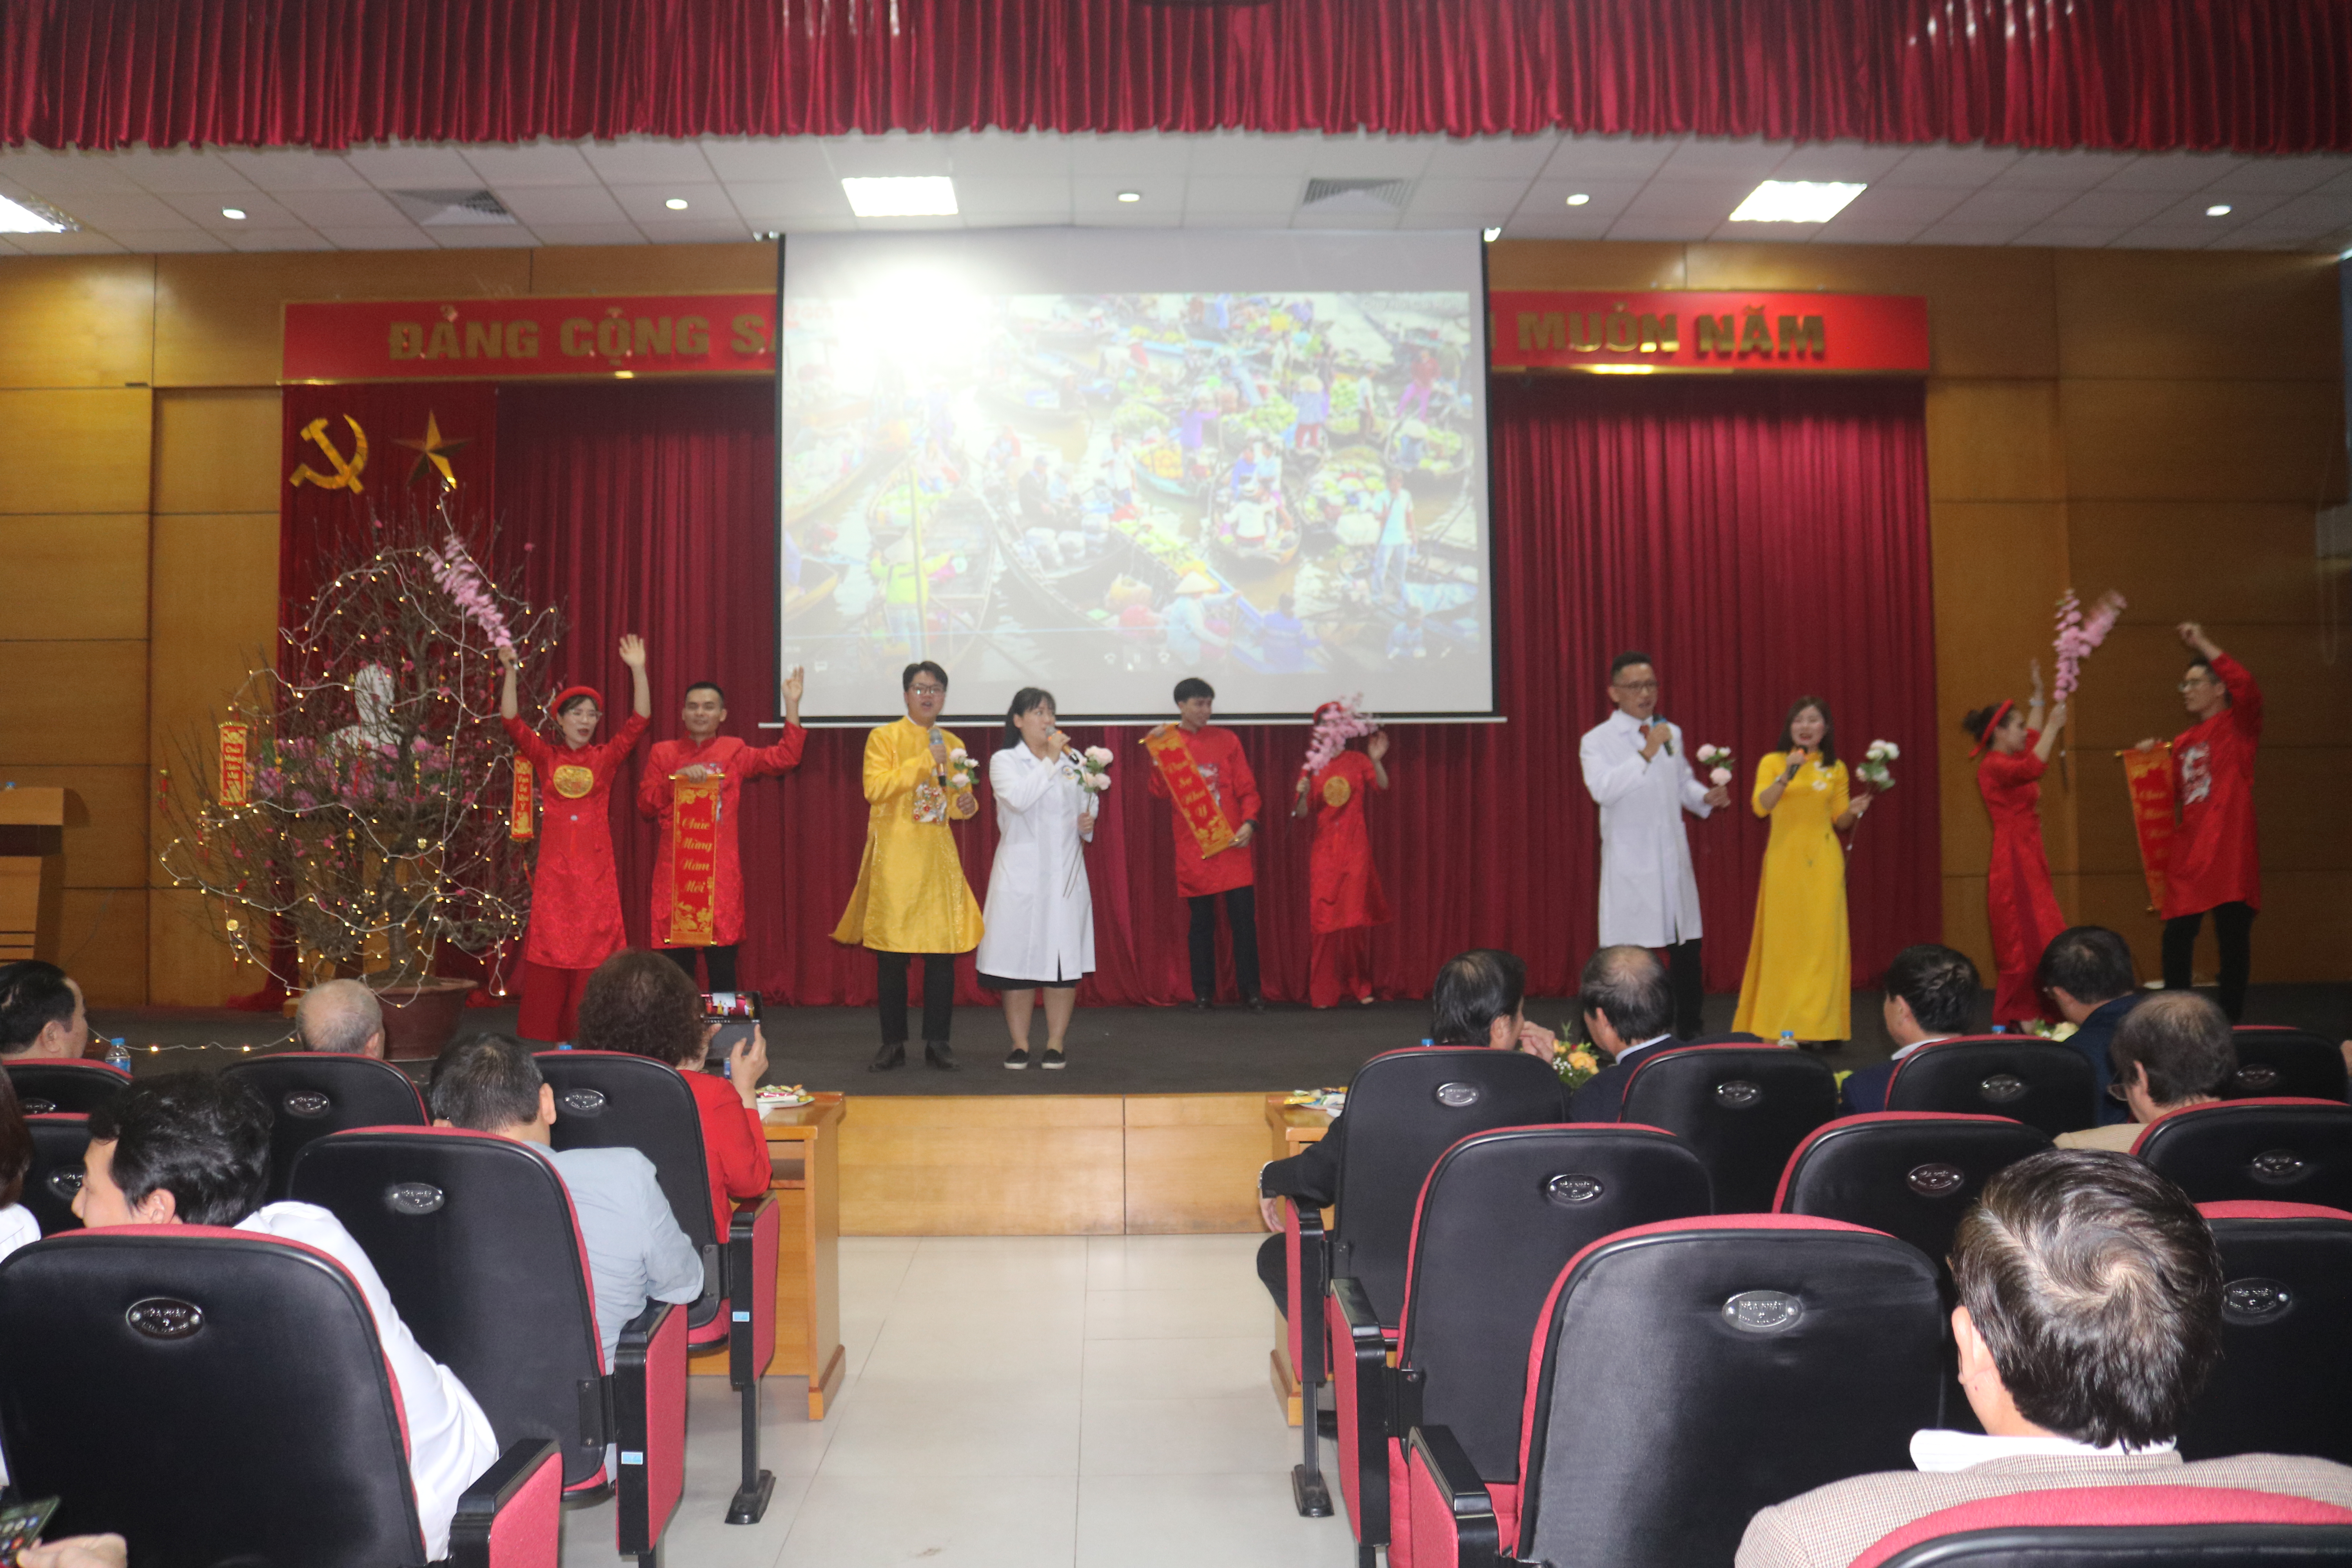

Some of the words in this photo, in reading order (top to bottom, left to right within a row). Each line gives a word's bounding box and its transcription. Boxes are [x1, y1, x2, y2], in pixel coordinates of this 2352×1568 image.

[388, 305, 539, 360] ĐẢNG
[560, 307, 709, 366] CỘNG
[1698, 304, 1825, 353] NĂM
